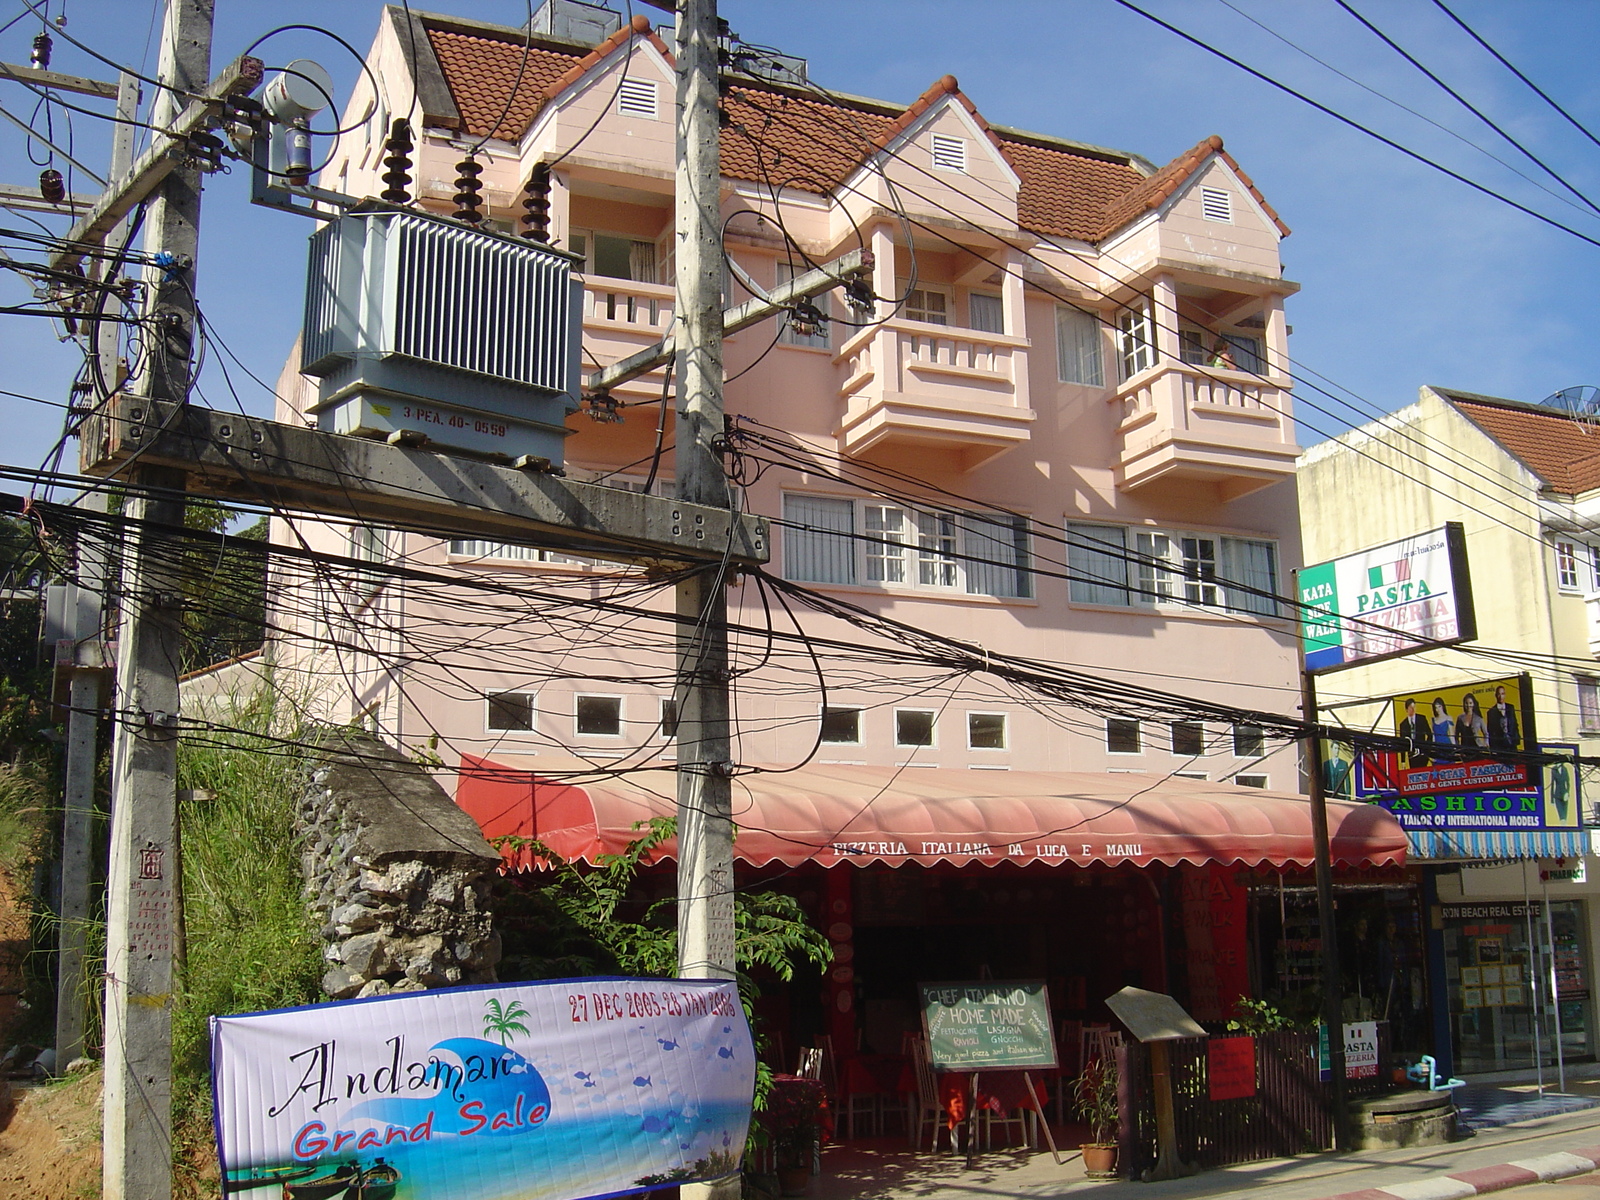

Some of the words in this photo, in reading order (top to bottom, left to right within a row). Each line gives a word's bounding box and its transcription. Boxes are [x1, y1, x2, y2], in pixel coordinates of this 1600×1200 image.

[1303, 582, 1333, 602] KATA
[1357, 579, 1431, 612] PASTA
[1346, 598, 1450, 638] PIZZERIA
[1306, 620, 1338, 639] WALK
[1408, 771, 1431, 784] NEW
[1440, 767, 1466, 780] STAR
[1470, 763, 1516, 778] FASHION
[1403, 781, 1429, 792] LADIES
[1438, 779, 1462, 788] GENTS
[1463, 776, 1494, 785] CUSTOM
[1404, 814, 1432, 826] TAILOR
[1434, 815, 1446, 826] OF
[1447, 815, 1508, 827] INTERNATIONAL
[1510, 816, 1540, 827] MODELS
[833, 841, 909, 855] PIZZERIA
[921, 841, 993, 855] ITALIANA
[1008, 843, 1025, 856] DA
[1036, 844, 1070, 857] LUCA
[1082, 844, 1092, 856] E
[1106, 843, 1142, 856] MANU
[1550, 869, 1584, 879] PHARMACY
[1461, 907, 1488, 918] BEACH
[1490, 906, 1511, 917] REAL
[568, 994, 588, 1022] 27
[592, 992, 623, 1021] DEC
[681, 991, 708, 1016] JAN
[708, 991, 735, 1017] 2006
[950, 1008, 988, 1025] HOME
[991, 1008, 1026, 1026] MADE
[986, 1025, 1022, 1035] LASAGNA
[953, 1037, 979, 1047] RAVIOLI
[991, 1036, 1023, 1044] GNOCCHI
[1345, 1042, 1374, 1052] ASTA
[934, 1050, 952, 1063] Very
[955, 1050, 969, 1062] good
[971, 1048, 990, 1060] pizza
[268, 1034, 512, 1117] Andaman
[1358, 1065, 1377, 1075] HOUSE
[292, 1109, 436, 1160] Grand
[458, 1093, 547, 1137] Sale
